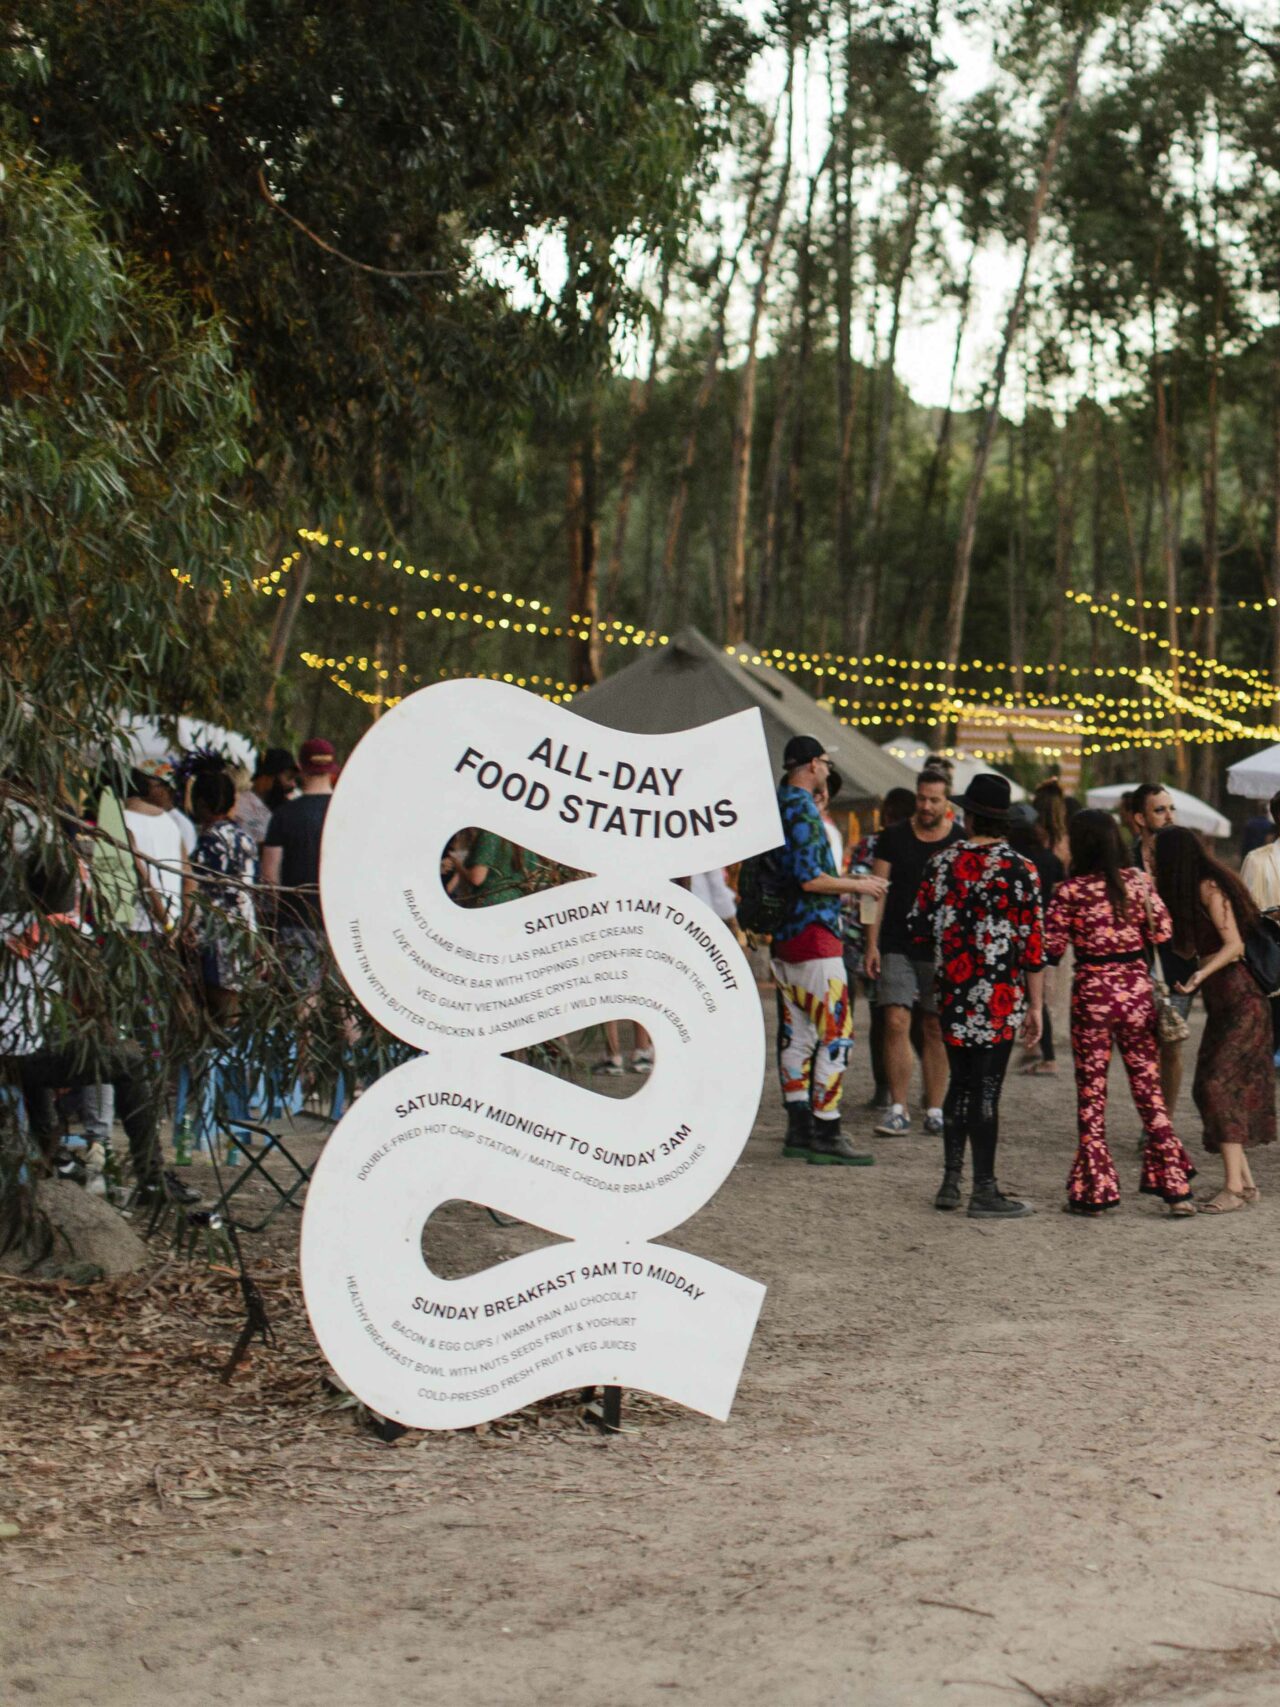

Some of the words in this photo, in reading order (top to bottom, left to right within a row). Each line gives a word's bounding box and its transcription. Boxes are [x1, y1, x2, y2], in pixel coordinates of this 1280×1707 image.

[454, 746, 551, 811] FOOD
[559, 794, 738, 838] STATIONS
[528, 737, 683, 796] ALL-DAY
[393, 928, 412, 952] LIVE
[408, 950, 468, 986] PANNEKOEK
[470, 979, 492, 988] BAR
[496, 975, 523, 987] WITH
[525, 958, 579, 980] TOPPINGS
[588, 948, 643, 963] OPEN-FIRE
[646, 950, 675, 965] CORN
[675, 961, 689, 974] ON
[689, 972, 707, 992] THE
[702, 991, 717, 1013] COB
[425, 929, 455, 952] LAMB
[455, 947, 499, 965] RIBLETS
[509, 951, 529, 963] LAS
[532, 937, 578, 958] PALETAS
[580, 931, 598, 943] ICE
[600, 926, 644, 939] CREAMS
[524, 901, 609, 935] SATURDAY
[617, 899, 661, 915] 11AM
[665, 906, 685, 925] TO
[685, 921, 738, 990] MIDNIGHT
[350, 919, 364, 953] TIFFIN
[358, 955, 371, 973] TIN
[367, 973, 389, 1000] WITH
[388, 998, 425, 1026] BUTTER
[427, 1021, 474, 1037] CHICKEN
[479, 1027, 485, 1036] &
[488, 1014, 535, 1034] JASMINE
[537, 1005, 560, 1020] RICE
[570, 997, 597, 1010] WILD
[600, 994, 662, 1011] MUSHROOM
[663, 1007, 692, 1043] KEBABS
[416, 986, 436, 1003] VEG
[439, 997, 472, 1012] GIANT
[475, 989, 544, 1012] VIETNAMESE
[545, 975, 592, 996] CRYSTAL
[594, 970, 629, 982] ROLLS
[357, 1127, 422, 1181] DOUBLE-FRIED
[424, 1124, 447, 1134] HOT
[450, 1125, 475, 1139] CHIP
[476, 1134, 521, 1158] STATION
[528, 1154, 571, 1178] MATURE
[572, 1171, 621, 1193] CHEDDAR
[395, 1092, 484, 1118] SATURDAY
[486, 1106, 567, 1146] MIDNIGHT
[569, 1137, 589, 1155] TO
[592, 1147, 656, 1167] SUNDAY
[660, 1124, 692, 1156] 3AM
[391, 1320, 426, 1345] BACON
[429, 1339, 436, 1348] &
[438, 1341, 460, 1351] EGG
[464, 1337, 493, 1351] CUPS
[501, 1320, 536, 1341] WARM
[537, 1309, 562, 1327] PAIN
[564, 1302, 578, 1314] AU
[580, 1291, 638, 1307] CHOCOLAT
[411, 1297, 478, 1320] SUNDAY
[485, 1270, 577, 1317] BREAKFAST
[581, 1262, 617, 1280] 9AM
[622, 1261, 643, 1275] TO
[647, 1265, 706, 1301] MIDDAY
[347, 1275, 370, 1322] HEALTHY
[364, 1323, 414, 1367] BREAKFAST
[415, 1362, 446, 1377] BOWL
[449, 1366, 478, 1377] WITH
[480, 1354, 509, 1372] NUTS
[510, 1339, 543, 1360] SEEDS
[545, 1325, 573, 1344] FRUIT
[577, 1322, 584, 1332] &
[586, 1317, 637, 1329] YOGHURT
[417, 1385, 499, 1402] COLD-PRESSED
[500, 1368, 534, 1389] FRESH
[535, 1352, 565, 1371] FRUIT
[567, 1347, 574, 1357] &
[576, 1342, 597, 1354] VEG
[600, 1340, 637, 1352] JUICES
